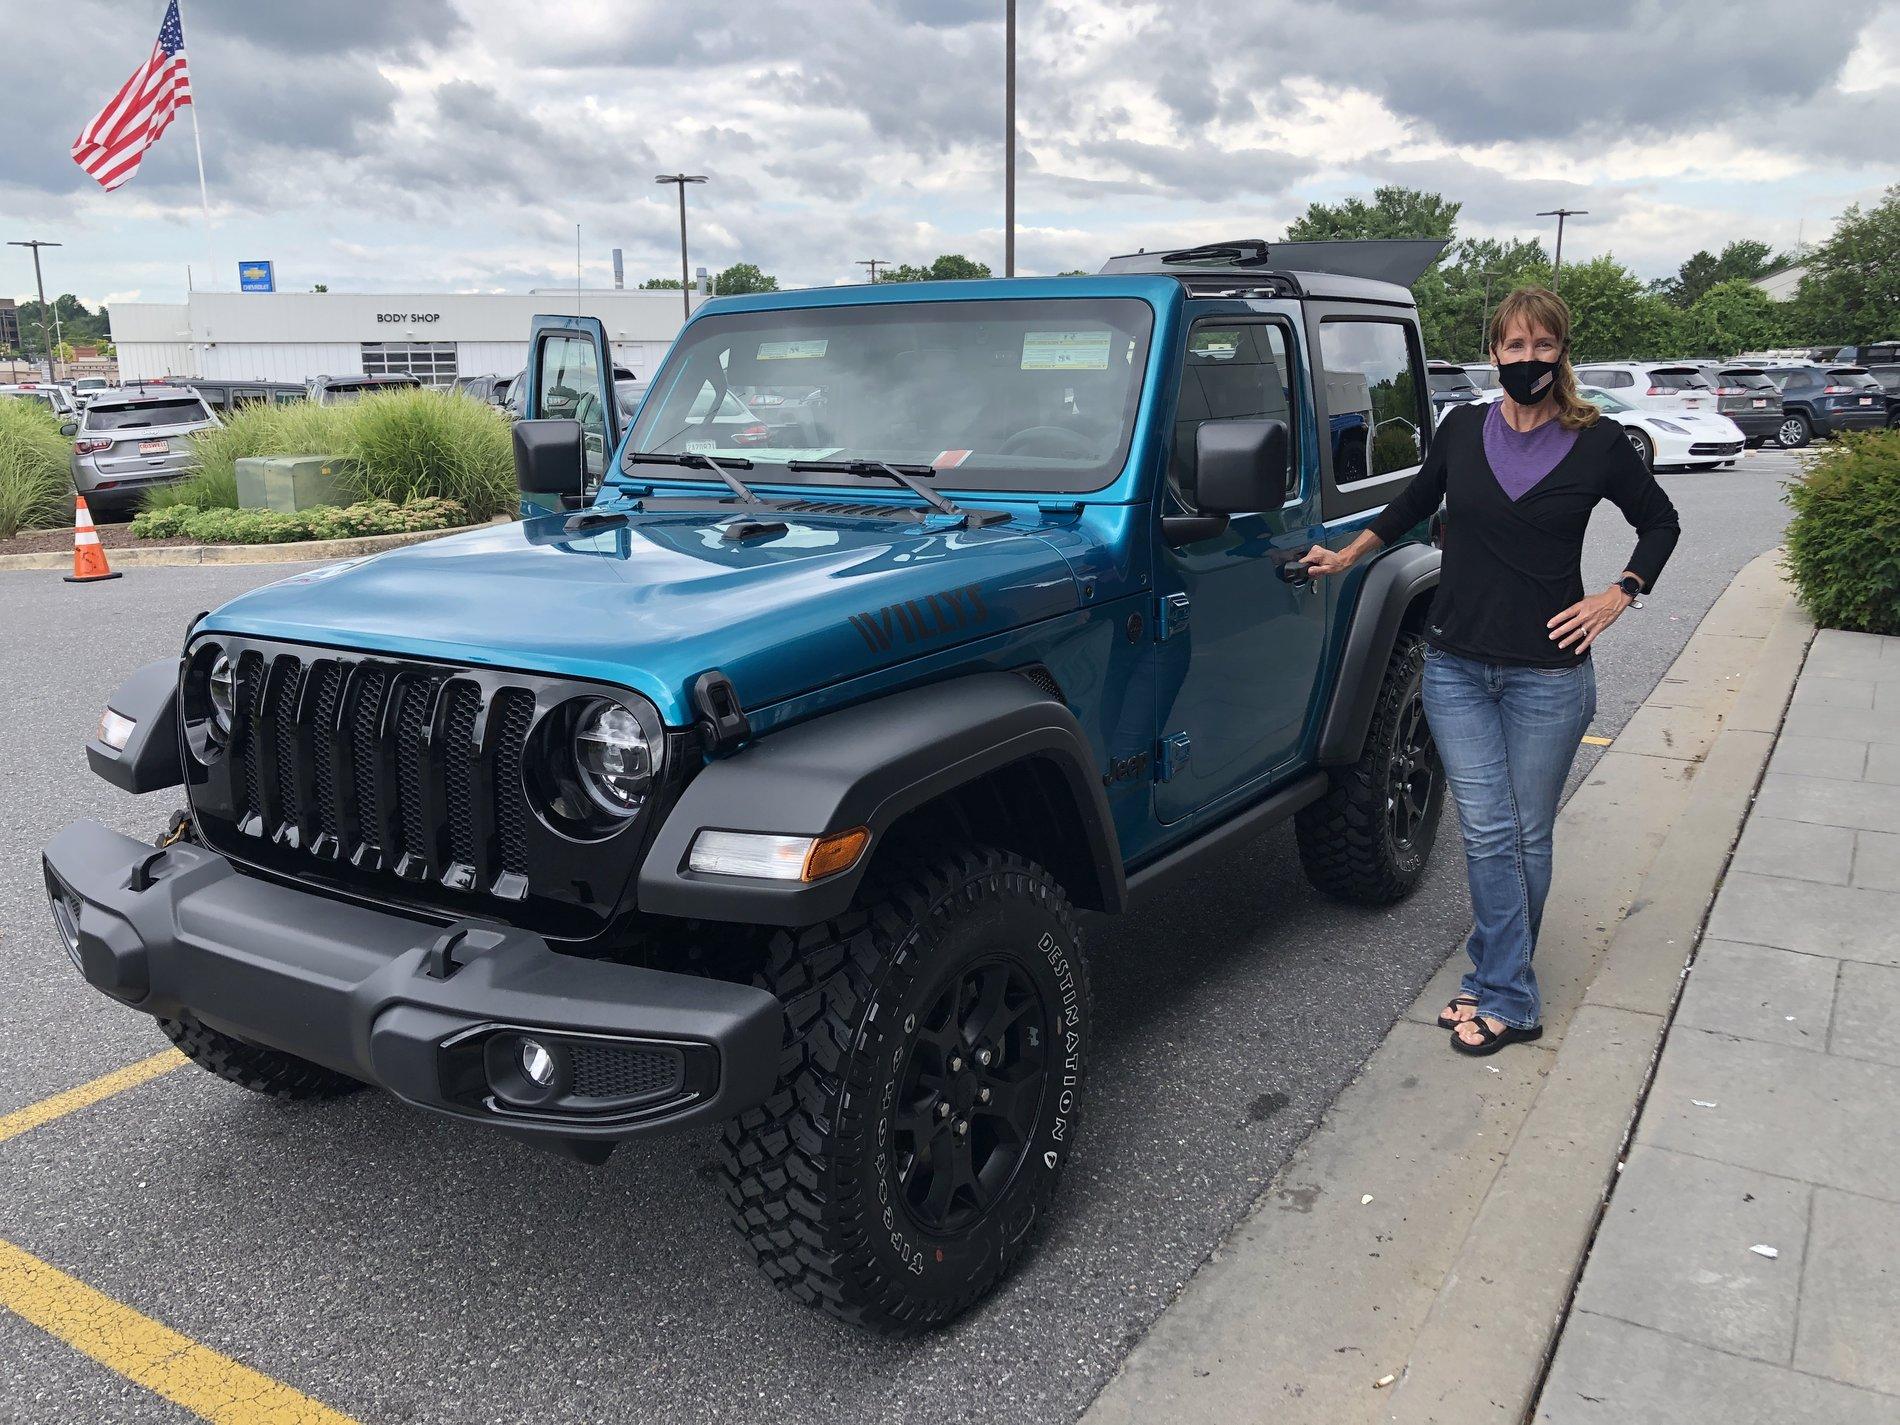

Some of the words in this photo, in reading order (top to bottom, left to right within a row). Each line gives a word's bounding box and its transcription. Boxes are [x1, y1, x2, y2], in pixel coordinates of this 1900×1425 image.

[376, 313, 408, 323] BODY
[411, 313, 440, 323] SHOP
[848, 583, 988, 655] WILLYS
[1102, 751, 1148, 786] Jeep
[1037, 931, 1080, 1143] DESTINATION
